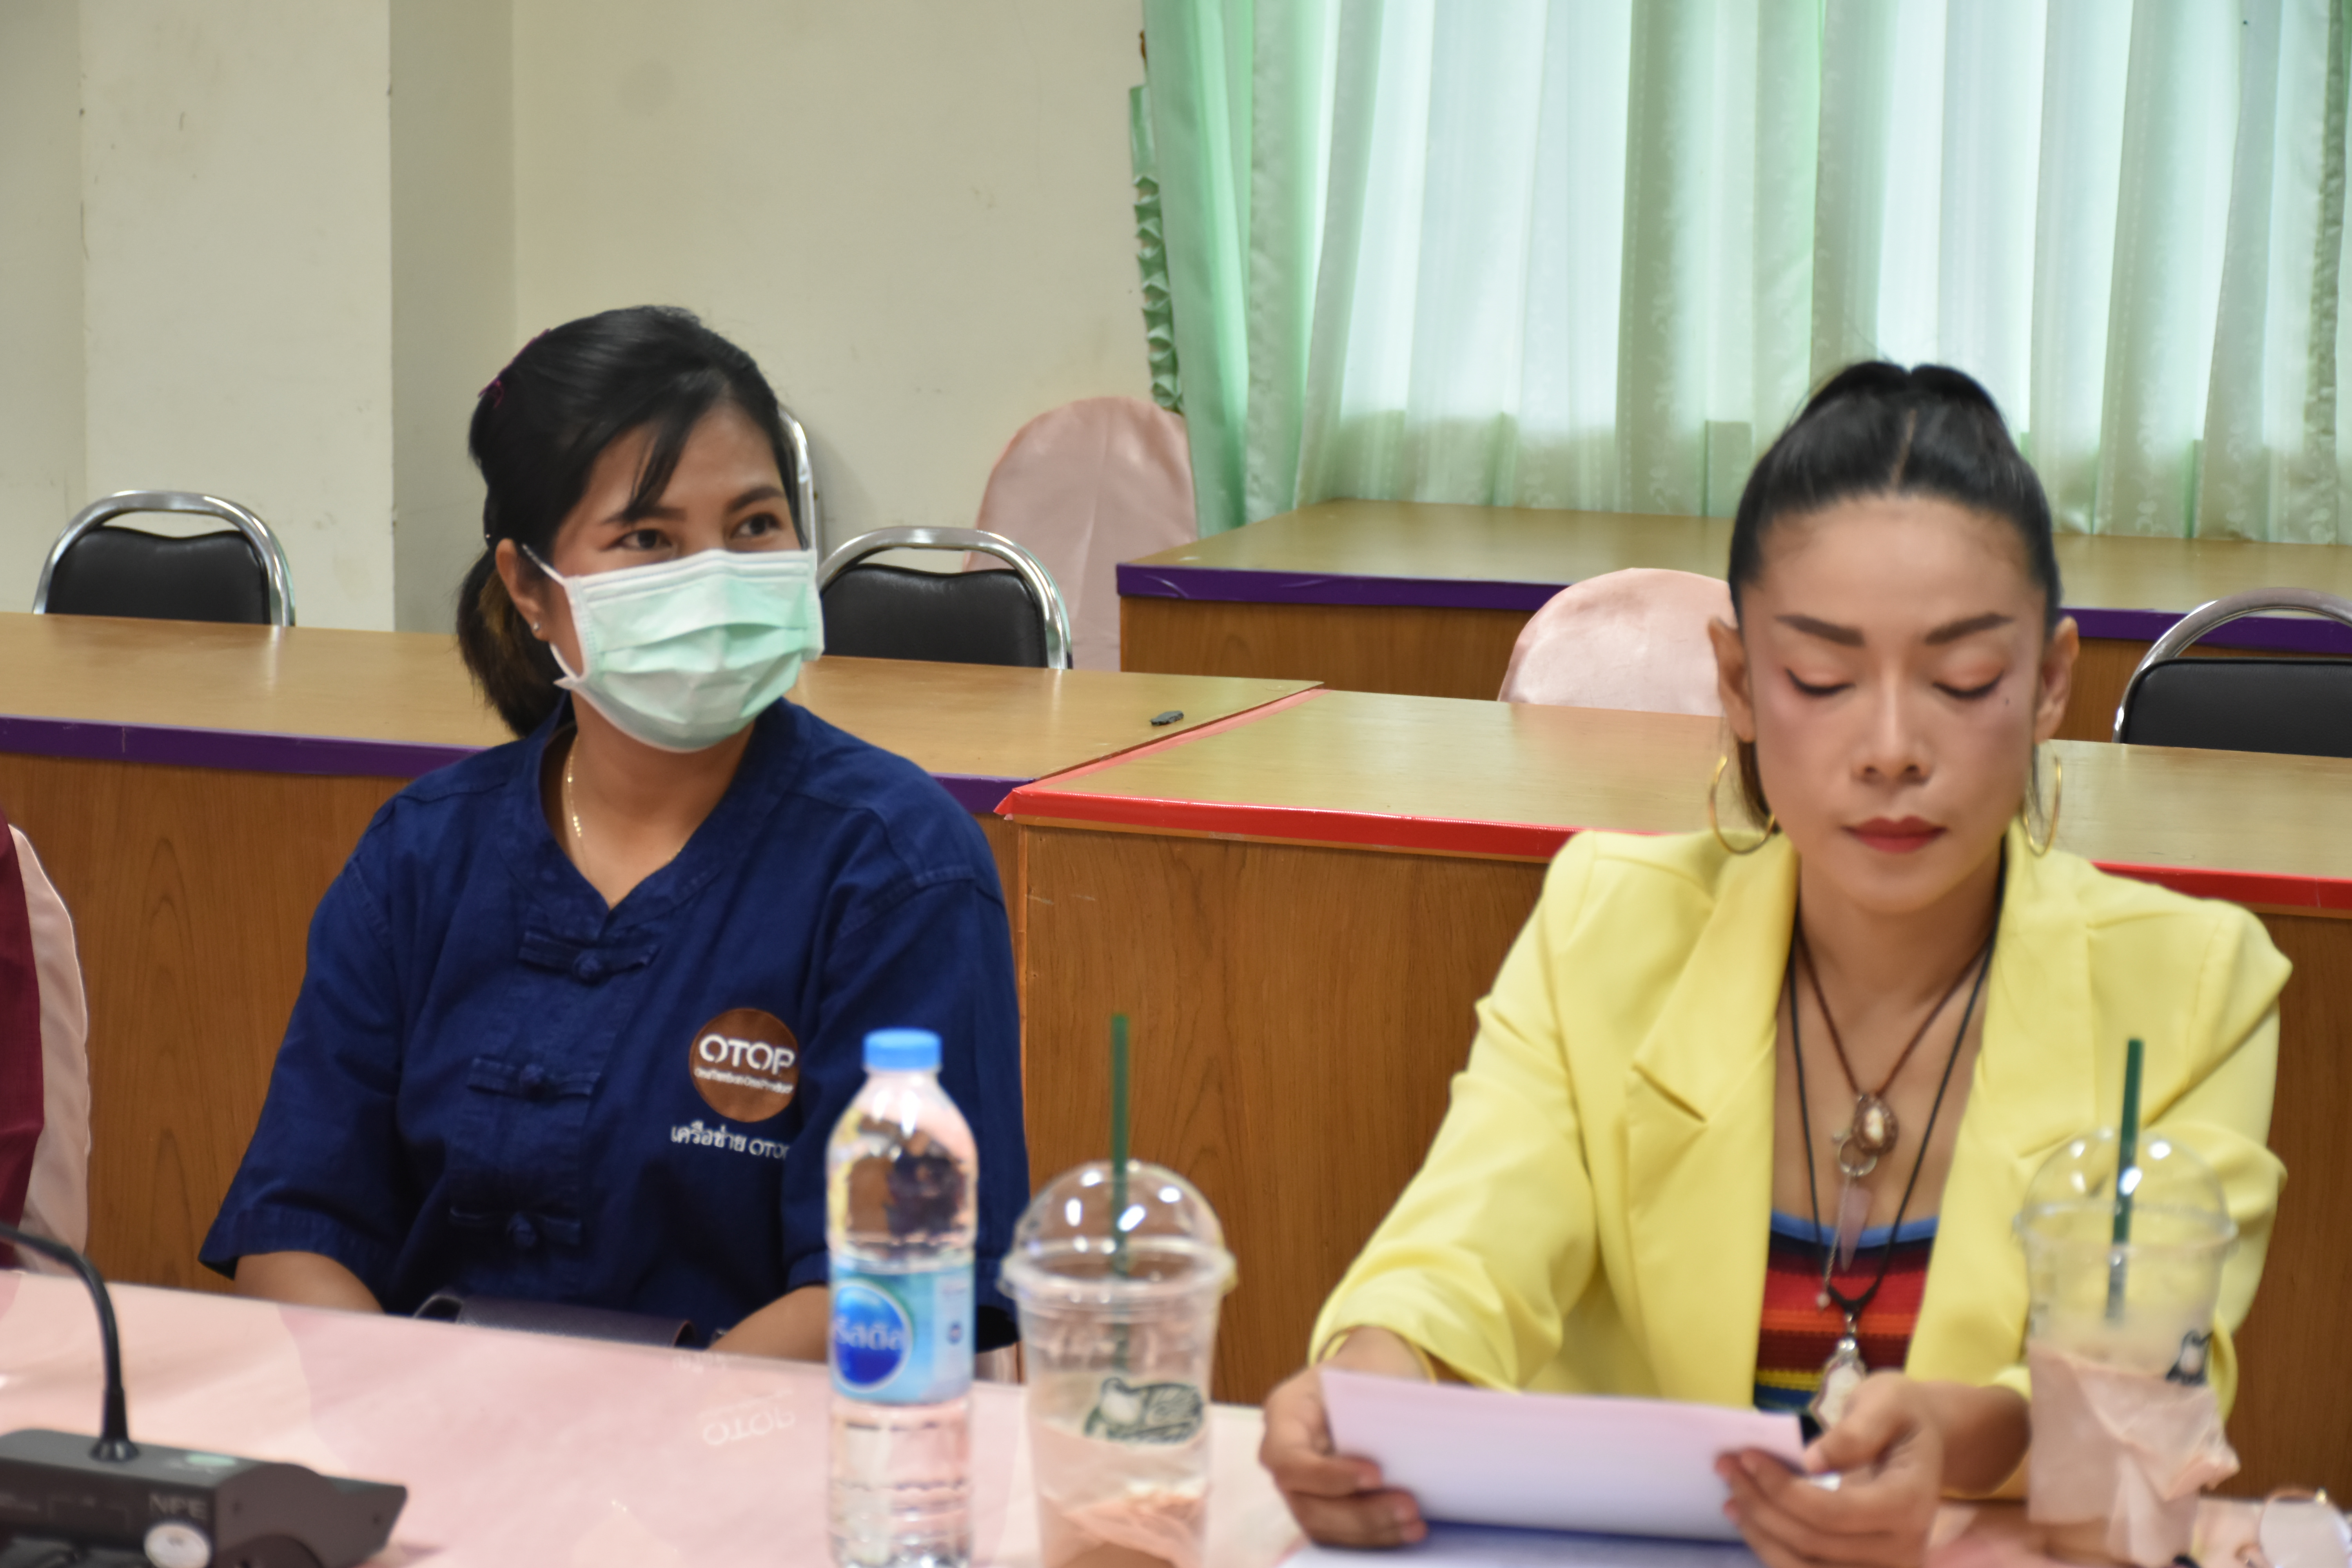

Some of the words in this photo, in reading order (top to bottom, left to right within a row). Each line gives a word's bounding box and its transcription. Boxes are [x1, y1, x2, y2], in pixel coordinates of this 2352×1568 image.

[699, 1034, 795, 1075] OTOP
[670, 1119, 747, 1152] เครือข่าย
